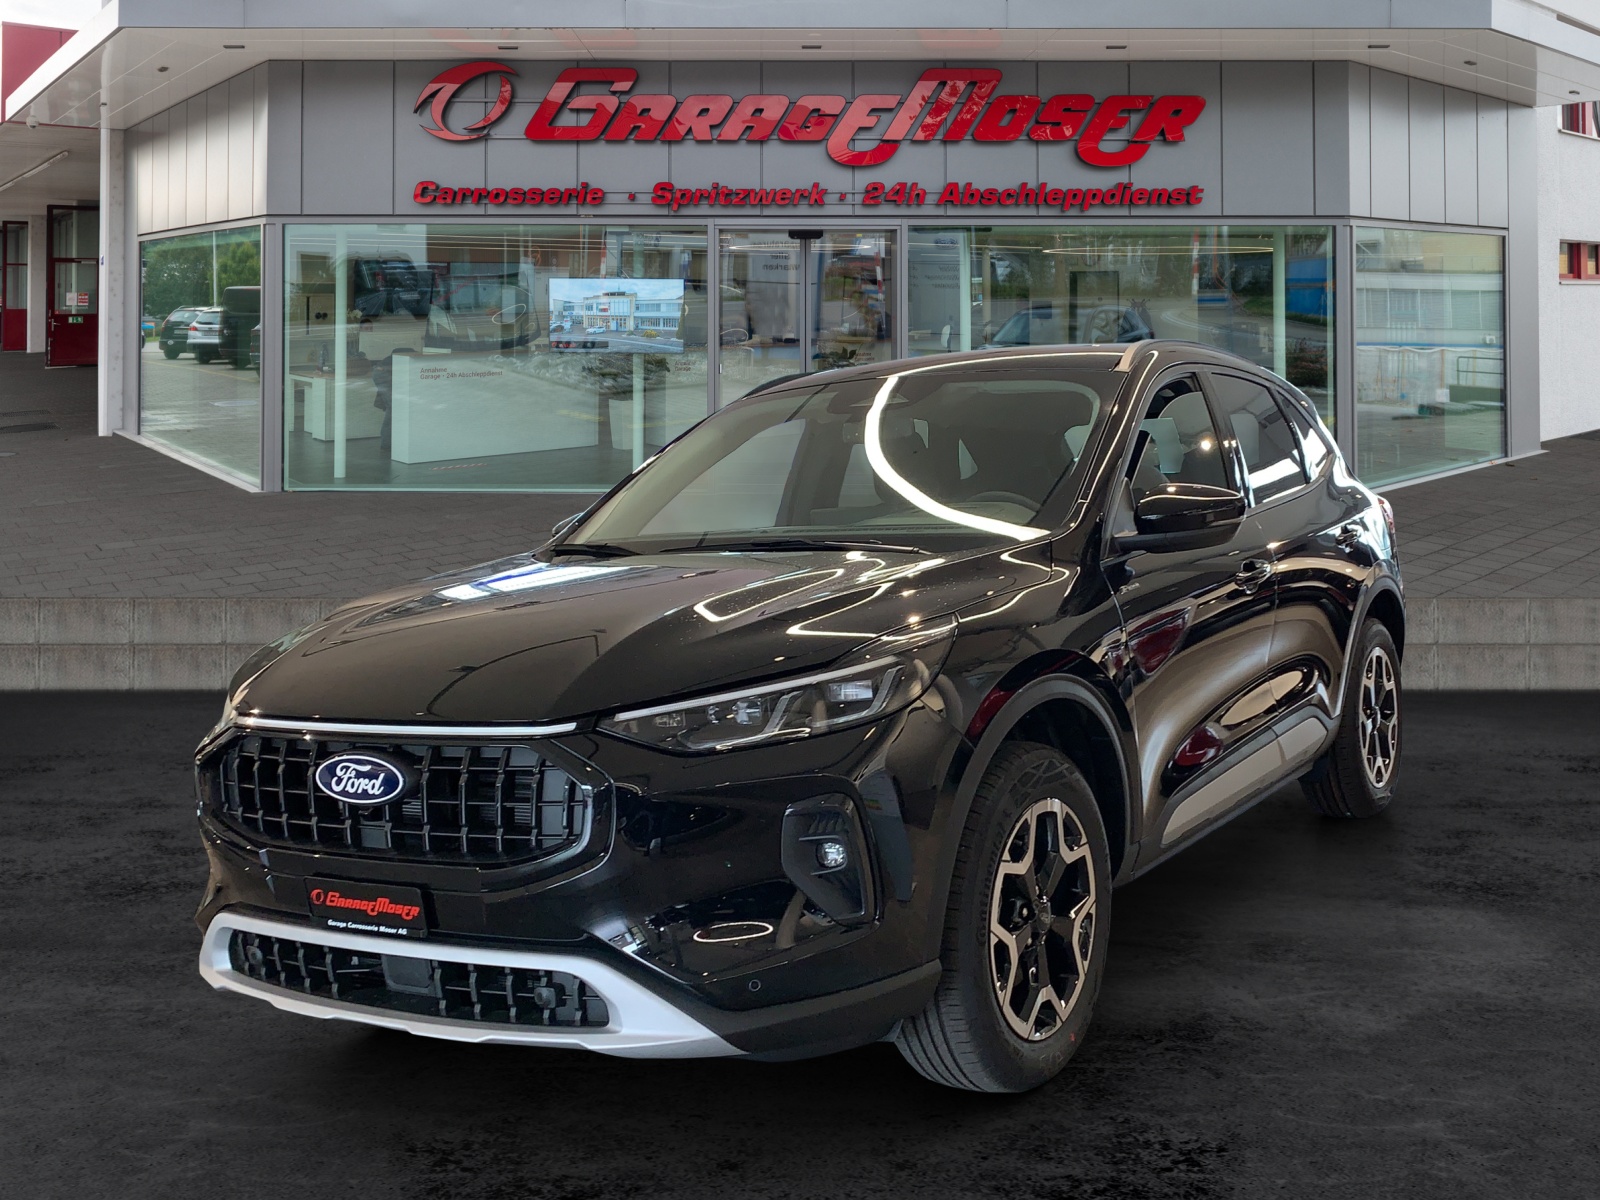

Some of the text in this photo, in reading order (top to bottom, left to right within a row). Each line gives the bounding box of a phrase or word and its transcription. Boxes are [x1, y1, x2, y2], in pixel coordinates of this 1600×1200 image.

[413, 181, 1204, 211] Carrosserie Spritzwerk 24h Abschleppdienst
[420, 366, 448, 374] Annahme
[458, 370, 503, 379] Abschleppdienst
[331, 762, 386, 796] Ford
[327, 919, 347, 929] Garage
[347, 922, 379, 932] Carrosserie
[379, 925, 398, 934] Moser
